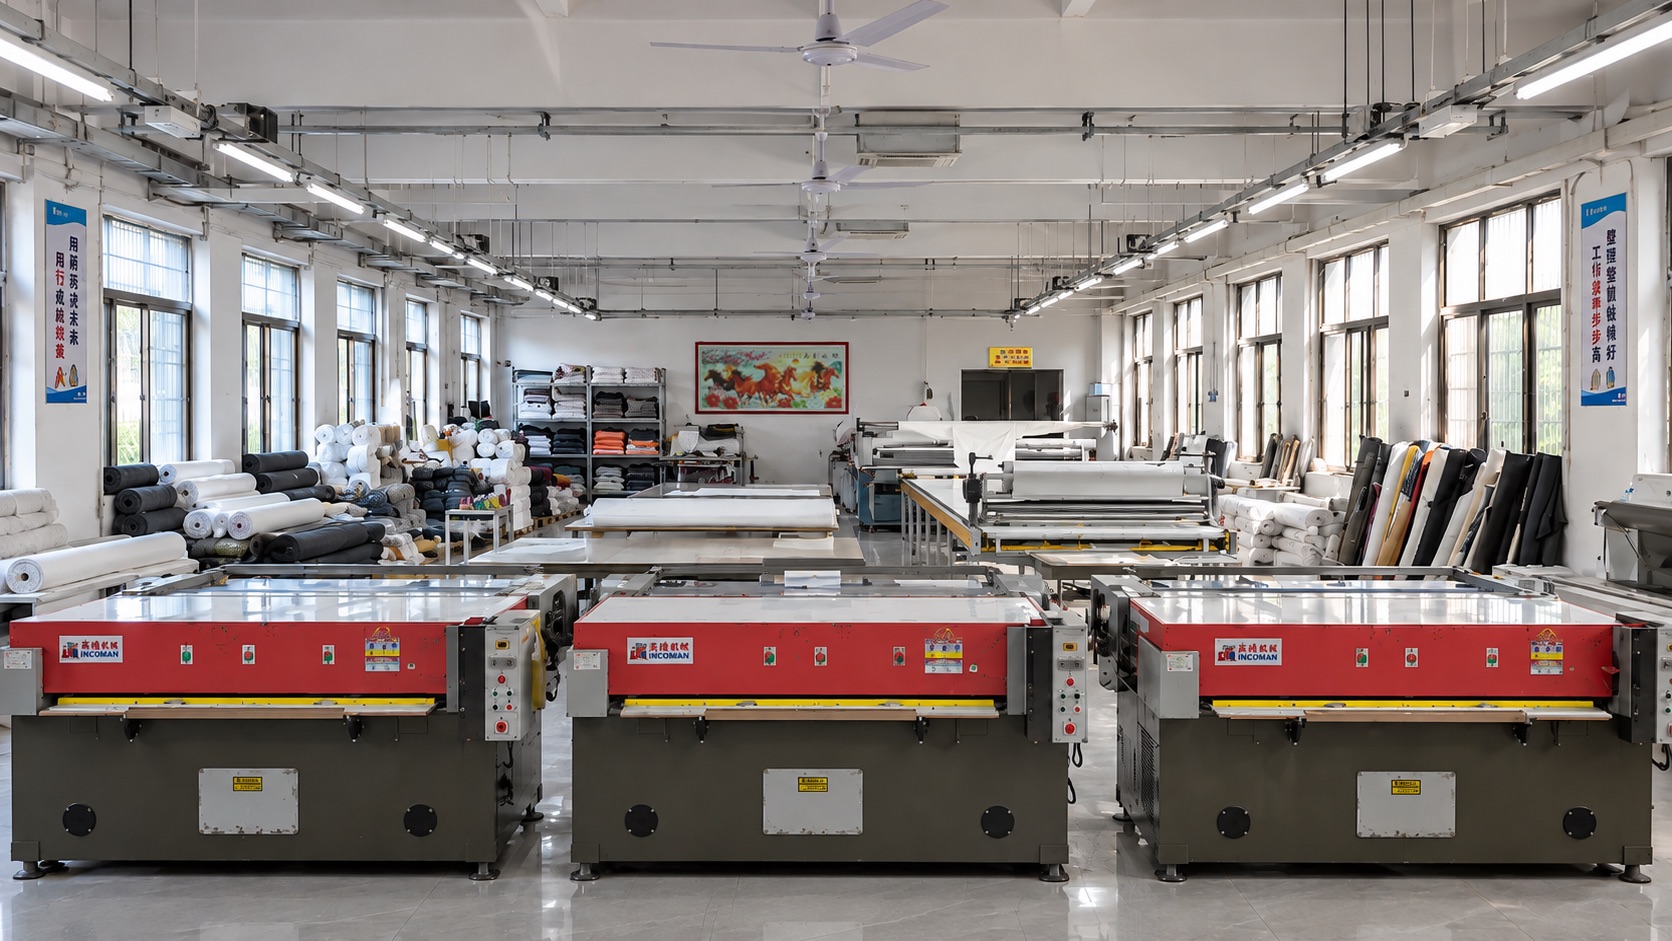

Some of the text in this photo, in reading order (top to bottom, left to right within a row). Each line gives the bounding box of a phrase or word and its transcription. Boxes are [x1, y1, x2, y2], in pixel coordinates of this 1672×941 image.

[80, 650, 119, 658] INCOMAN
[649, 652, 690, 660] INCOMAN
[1237, 653, 1278, 661] INCOMAN
